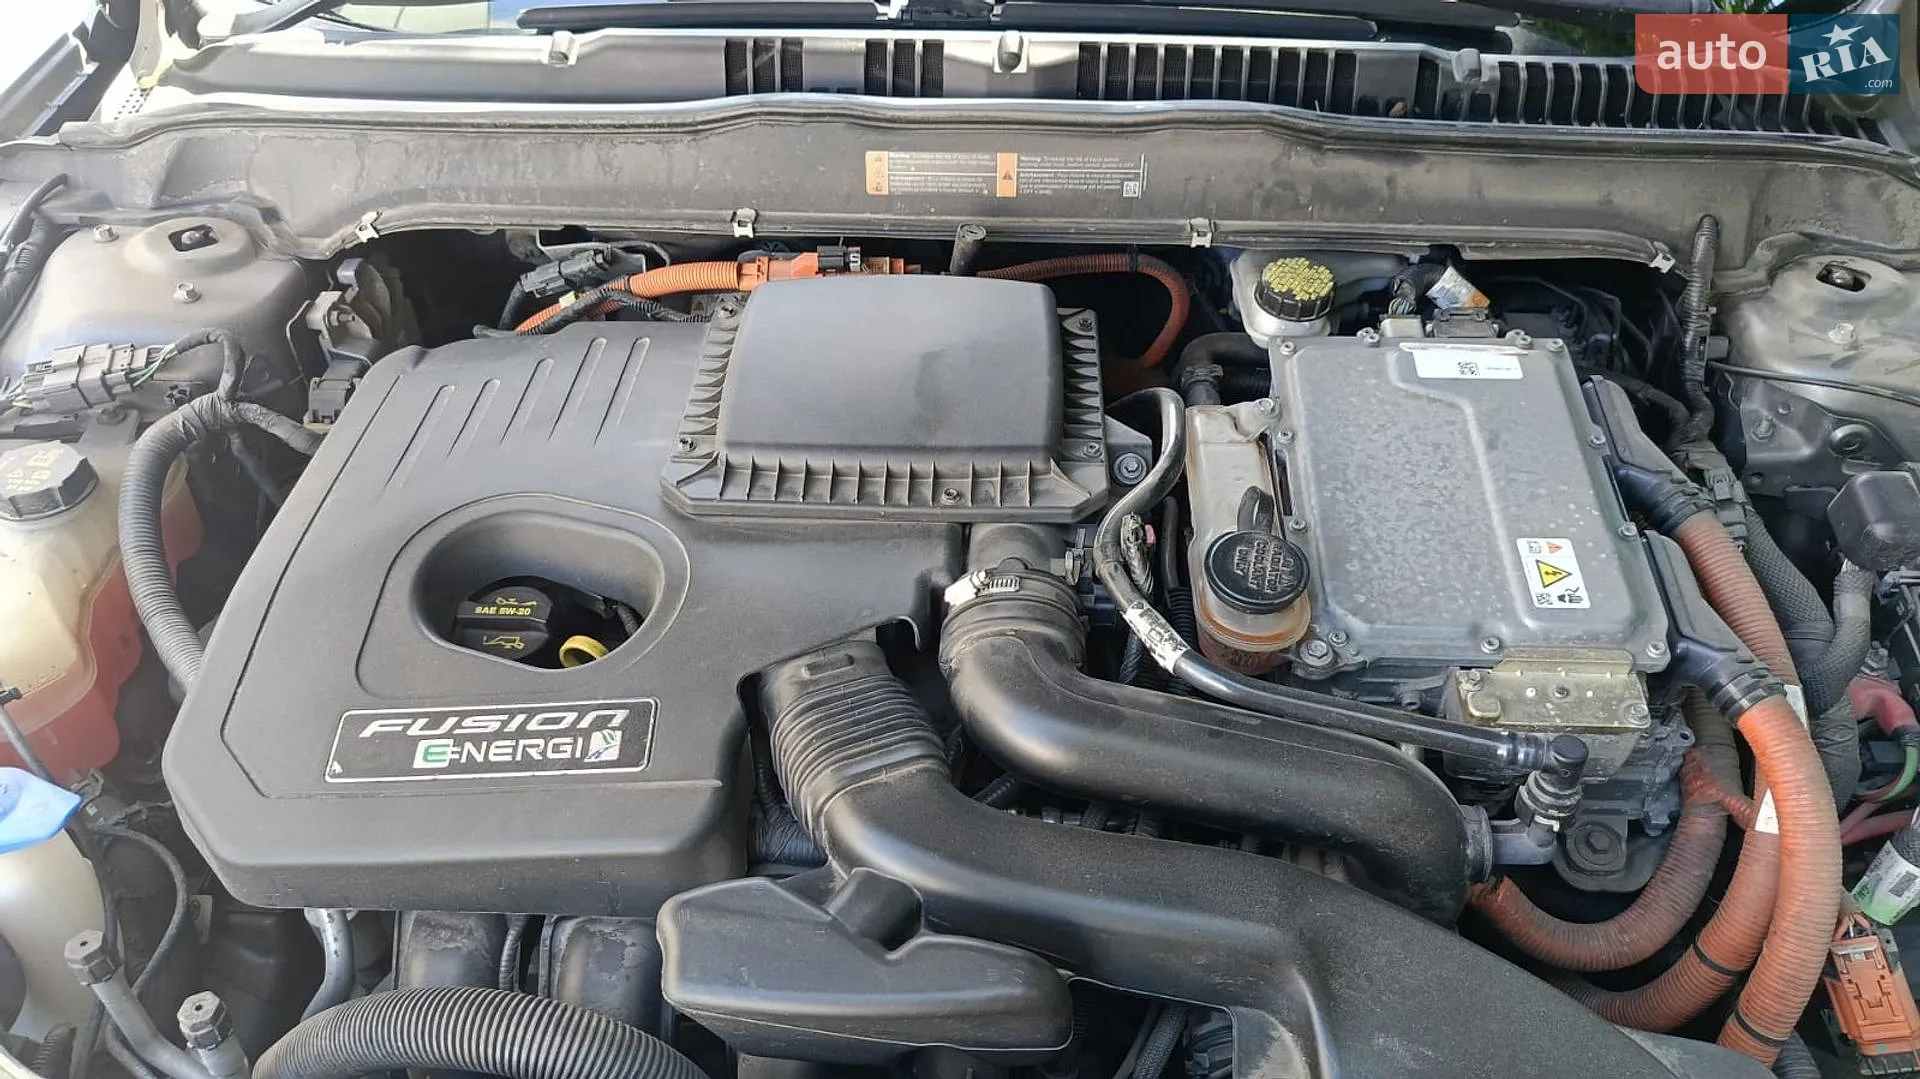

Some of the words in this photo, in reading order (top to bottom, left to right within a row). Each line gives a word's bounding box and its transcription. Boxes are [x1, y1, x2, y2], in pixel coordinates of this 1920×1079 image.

[475, 606, 497, 614] SAE
[499, 607, 531, 616] 5W-20
[359, 709, 630, 738] FUSION
